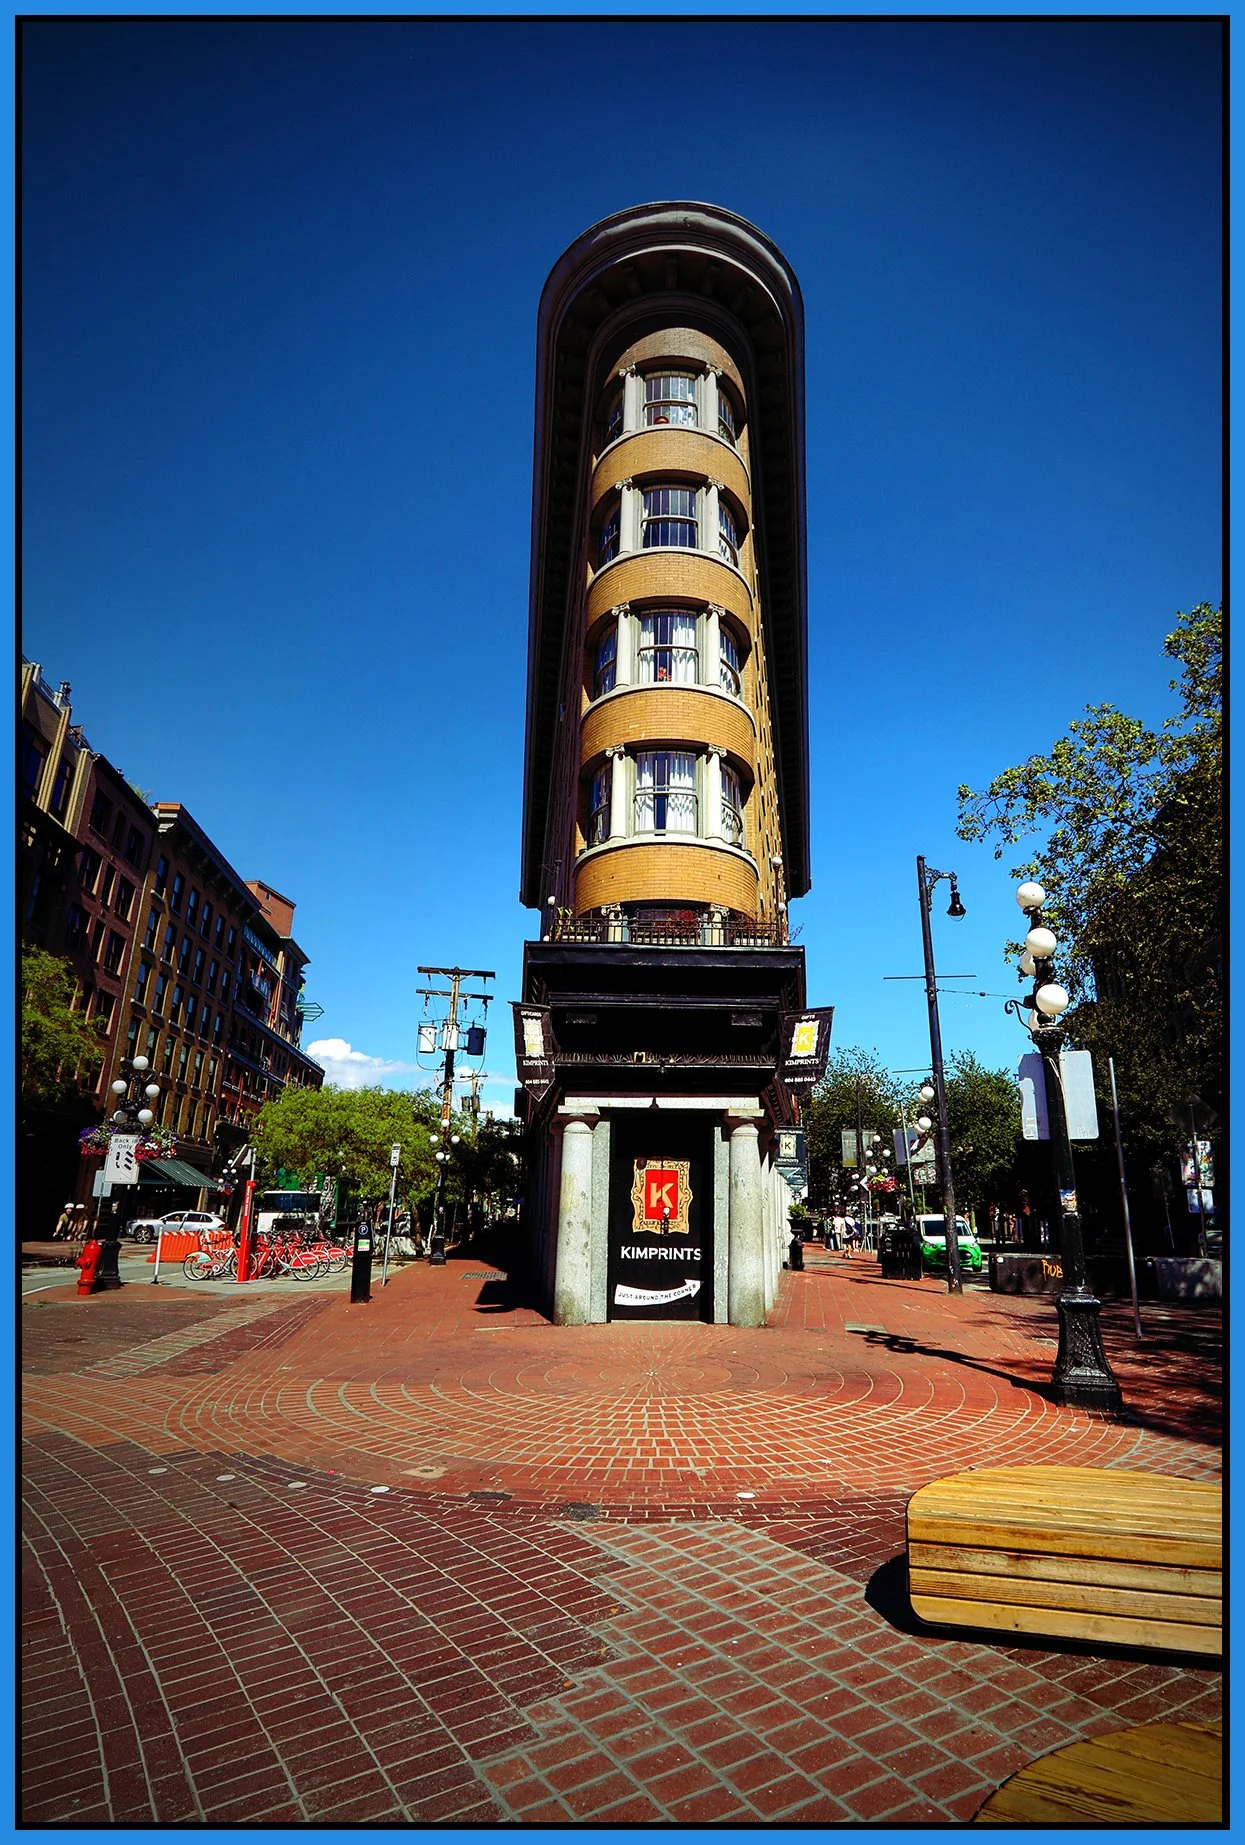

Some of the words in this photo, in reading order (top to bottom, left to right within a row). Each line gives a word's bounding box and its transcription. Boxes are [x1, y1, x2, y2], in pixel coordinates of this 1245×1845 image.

[799, 1032, 811, 1047] K
[785, 1058, 819, 1066] KIMPRINTS
[784, 1142, 791, 1150] K
[650, 1182, 674, 1208] K
[620, 1246, 702, 1261] KIMPRINTS
[673, 1283, 697, 1297] CORNER
